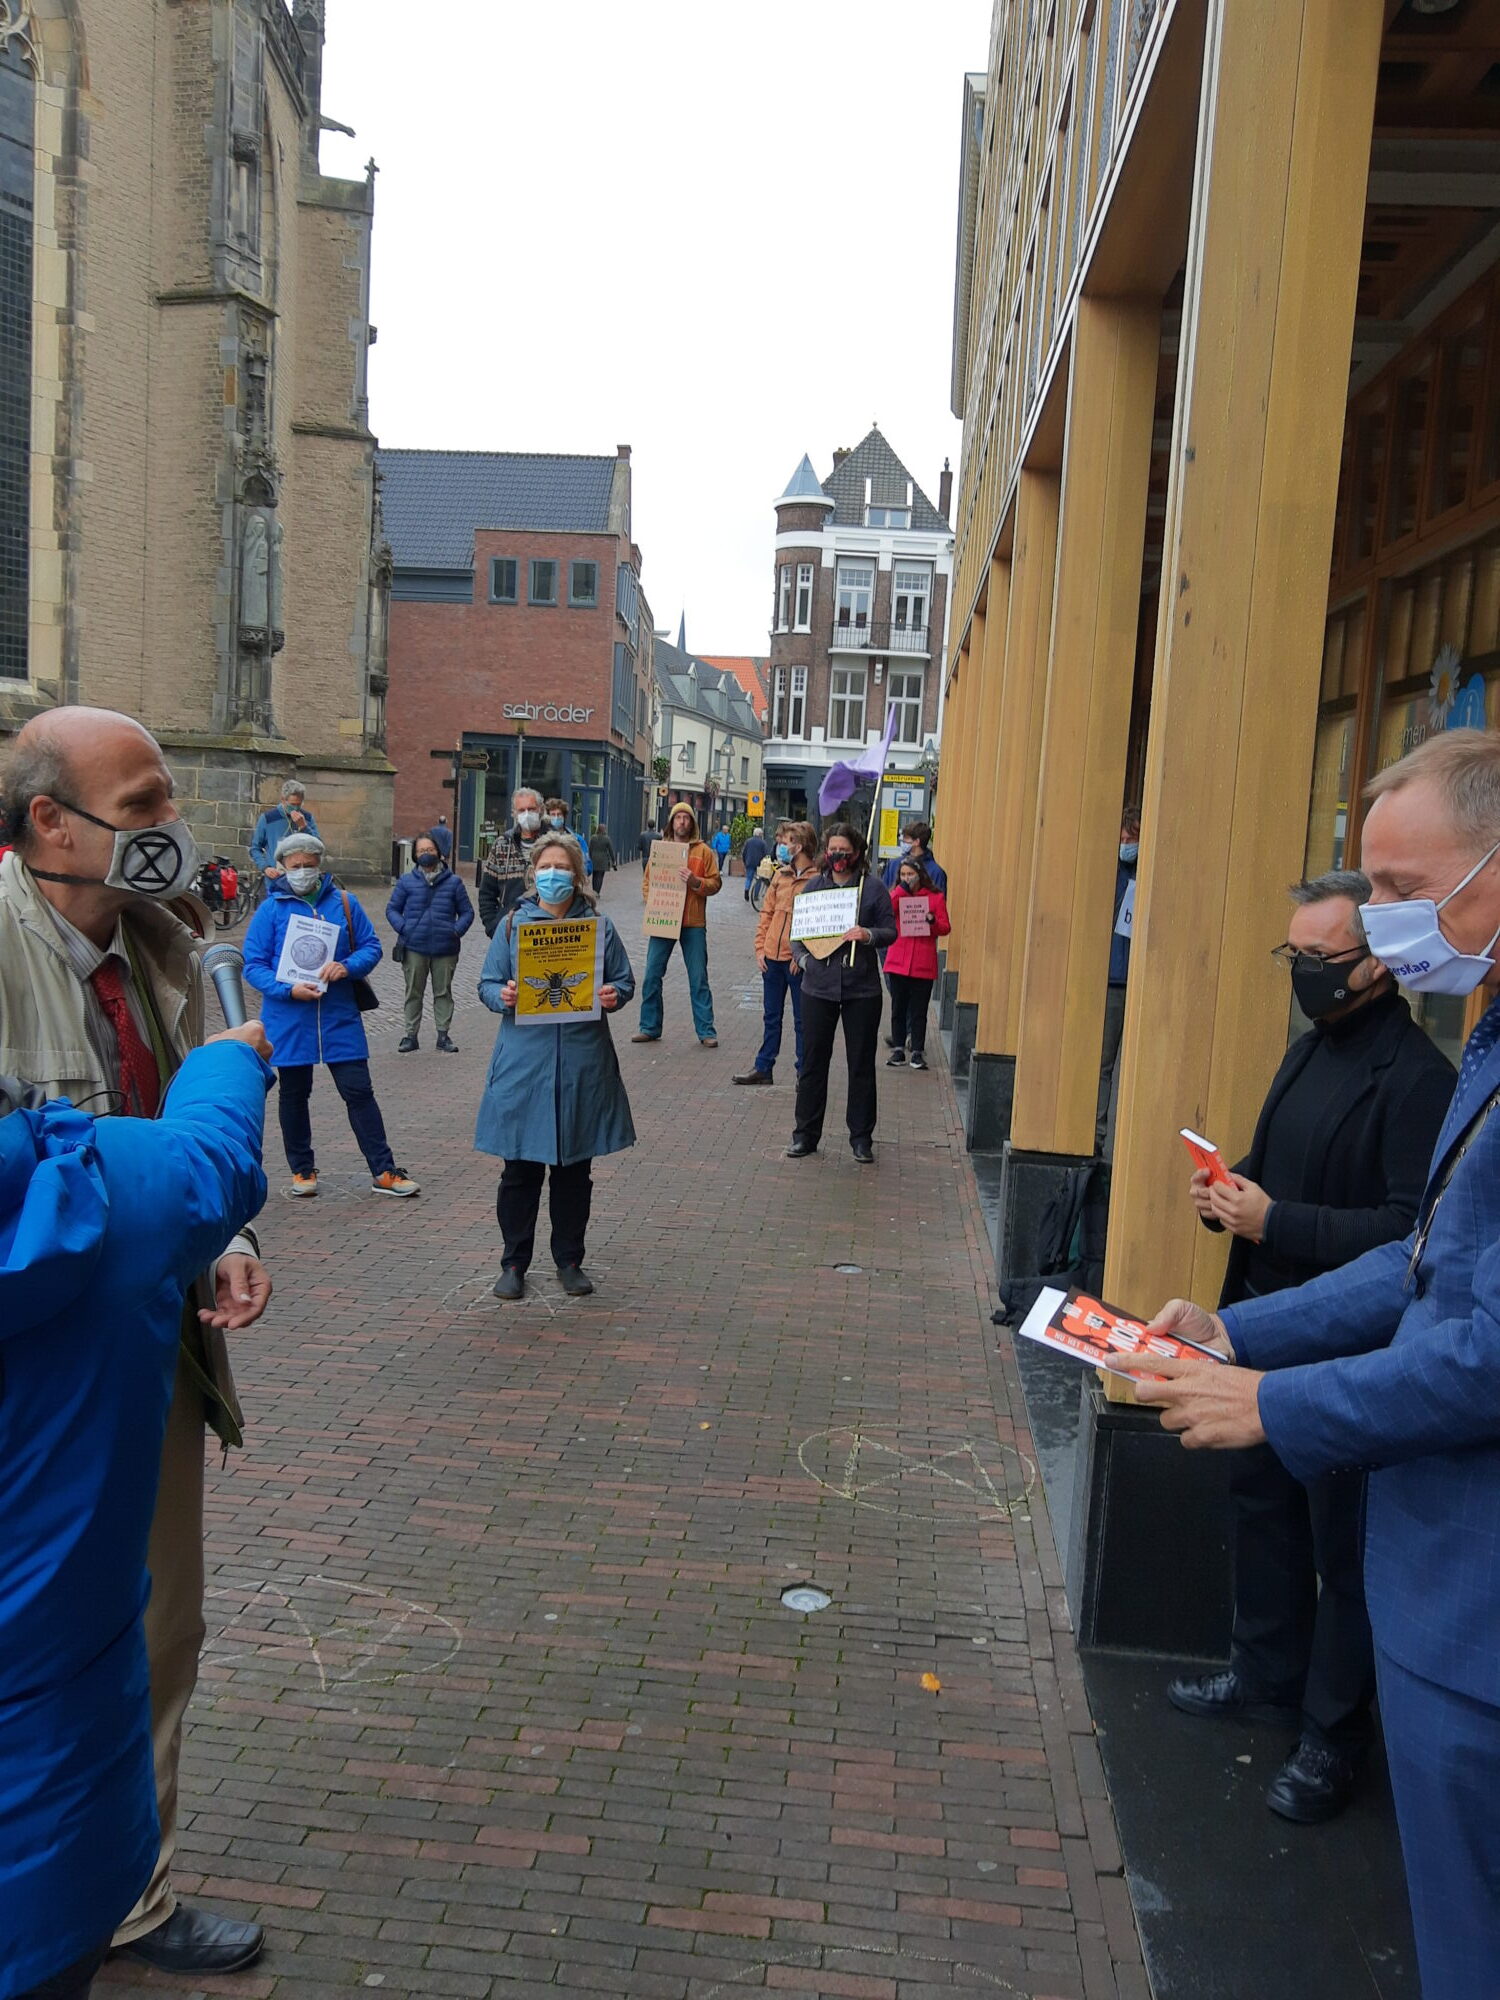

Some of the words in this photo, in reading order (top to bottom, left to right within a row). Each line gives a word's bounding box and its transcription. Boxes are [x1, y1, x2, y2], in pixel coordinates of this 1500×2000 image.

[502, 700, 595, 723] schräder
[523, 928, 546, 936] LAAT
[552, 925, 590, 934] BURGERS
[533, 935, 581, 946] BESLISSEN
